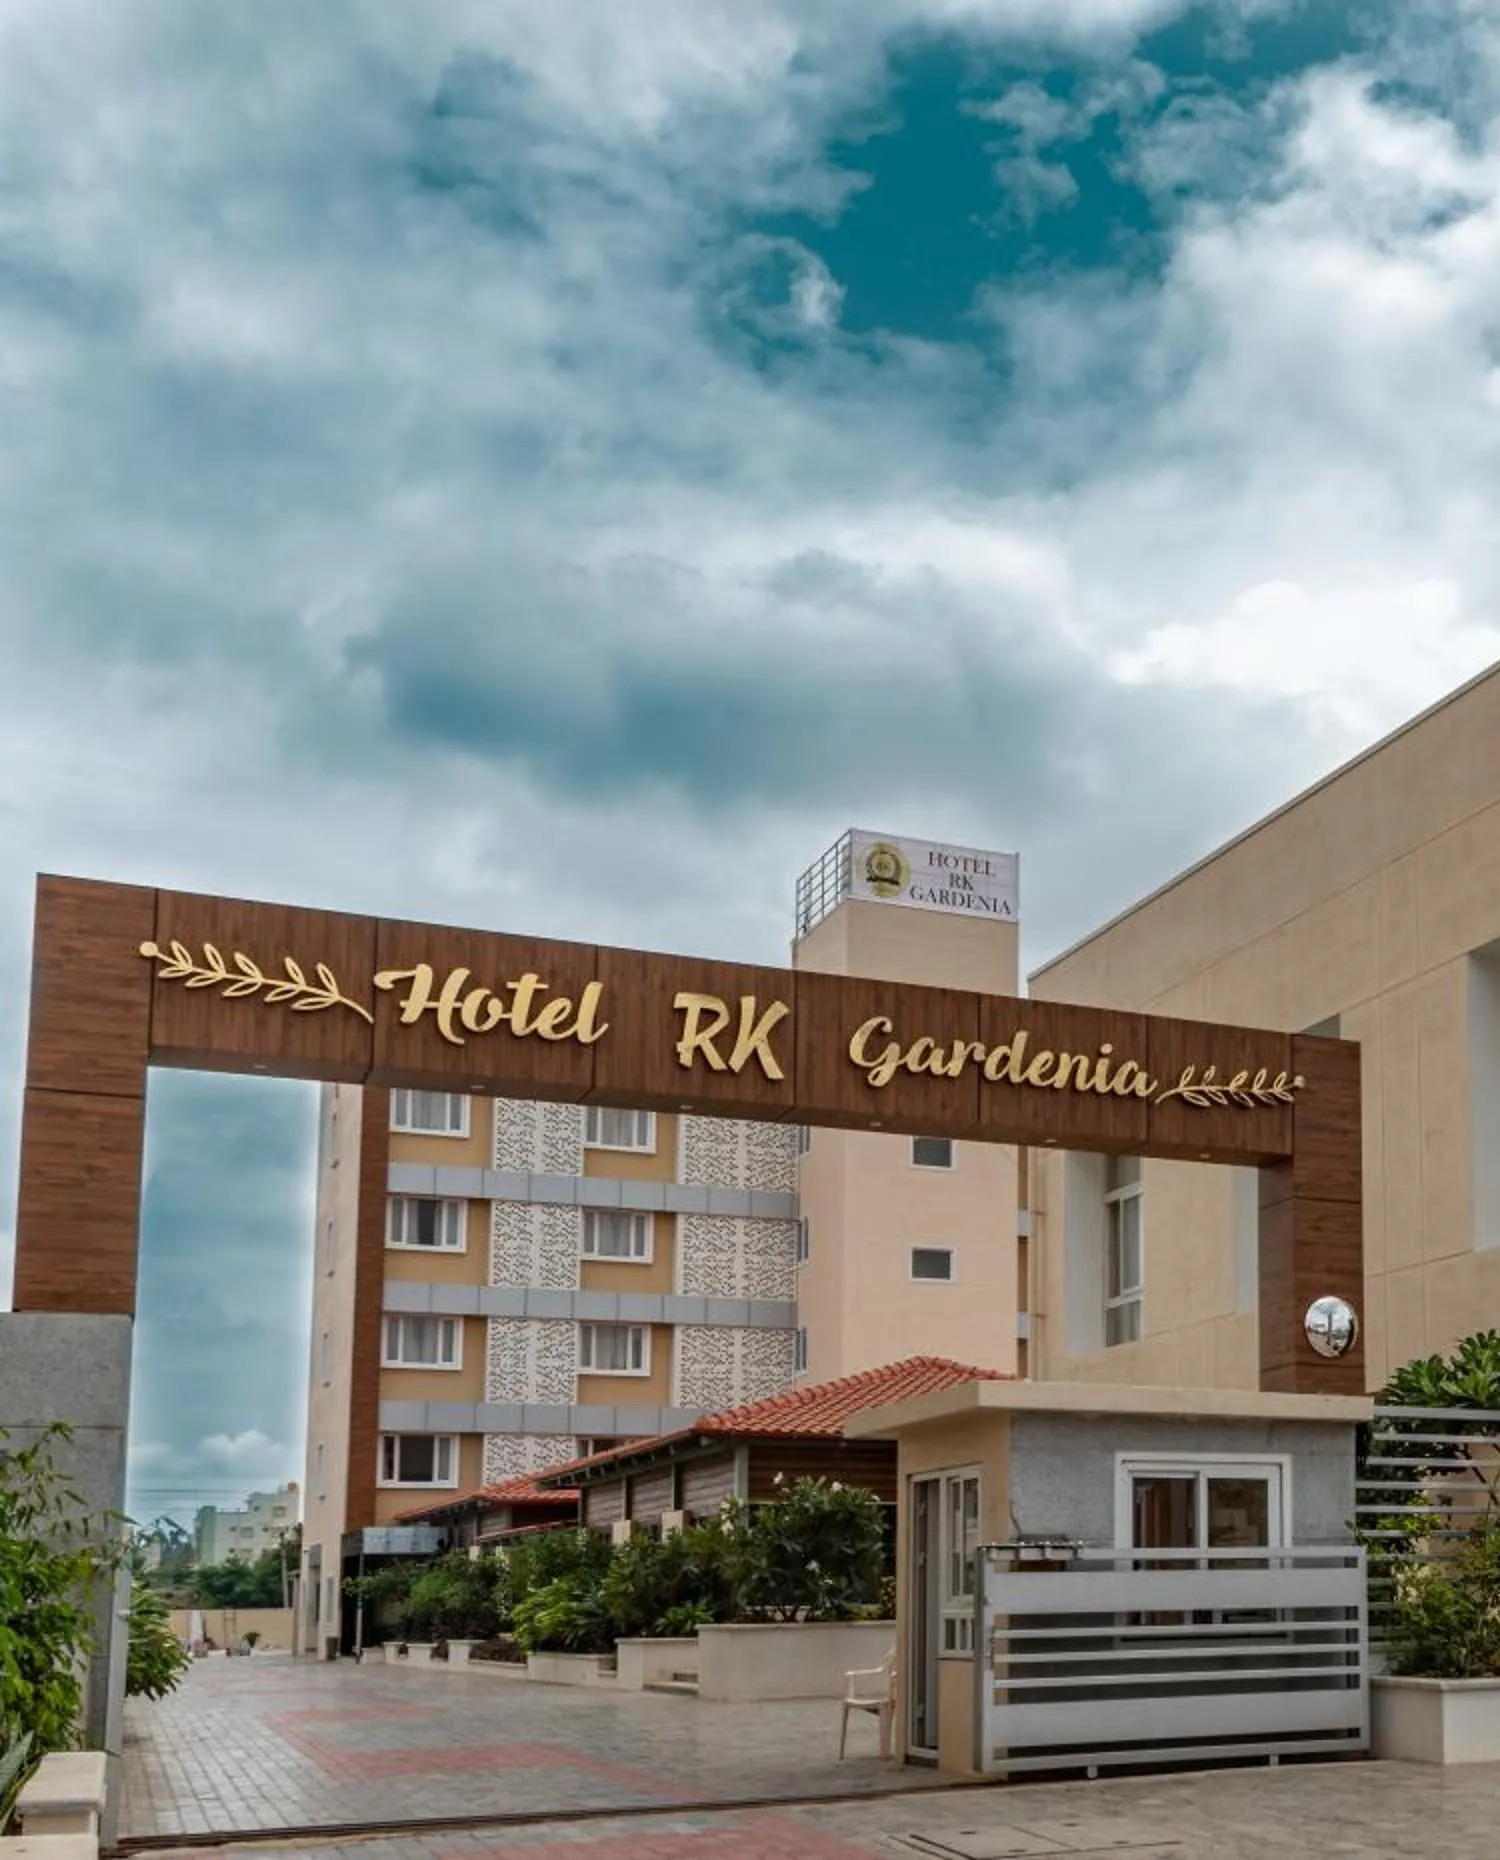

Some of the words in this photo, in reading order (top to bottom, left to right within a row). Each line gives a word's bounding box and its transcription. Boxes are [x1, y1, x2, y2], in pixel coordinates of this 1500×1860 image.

[929, 852, 995, 876] HOTEL
[950, 875, 974, 891] RK
[910, 887, 1011, 915] GARDENIA
[374, 963, 609, 1045] Hotel
[673, 992, 790, 1080] RK
[849, 1016, 1158, 1098] Gardenia
